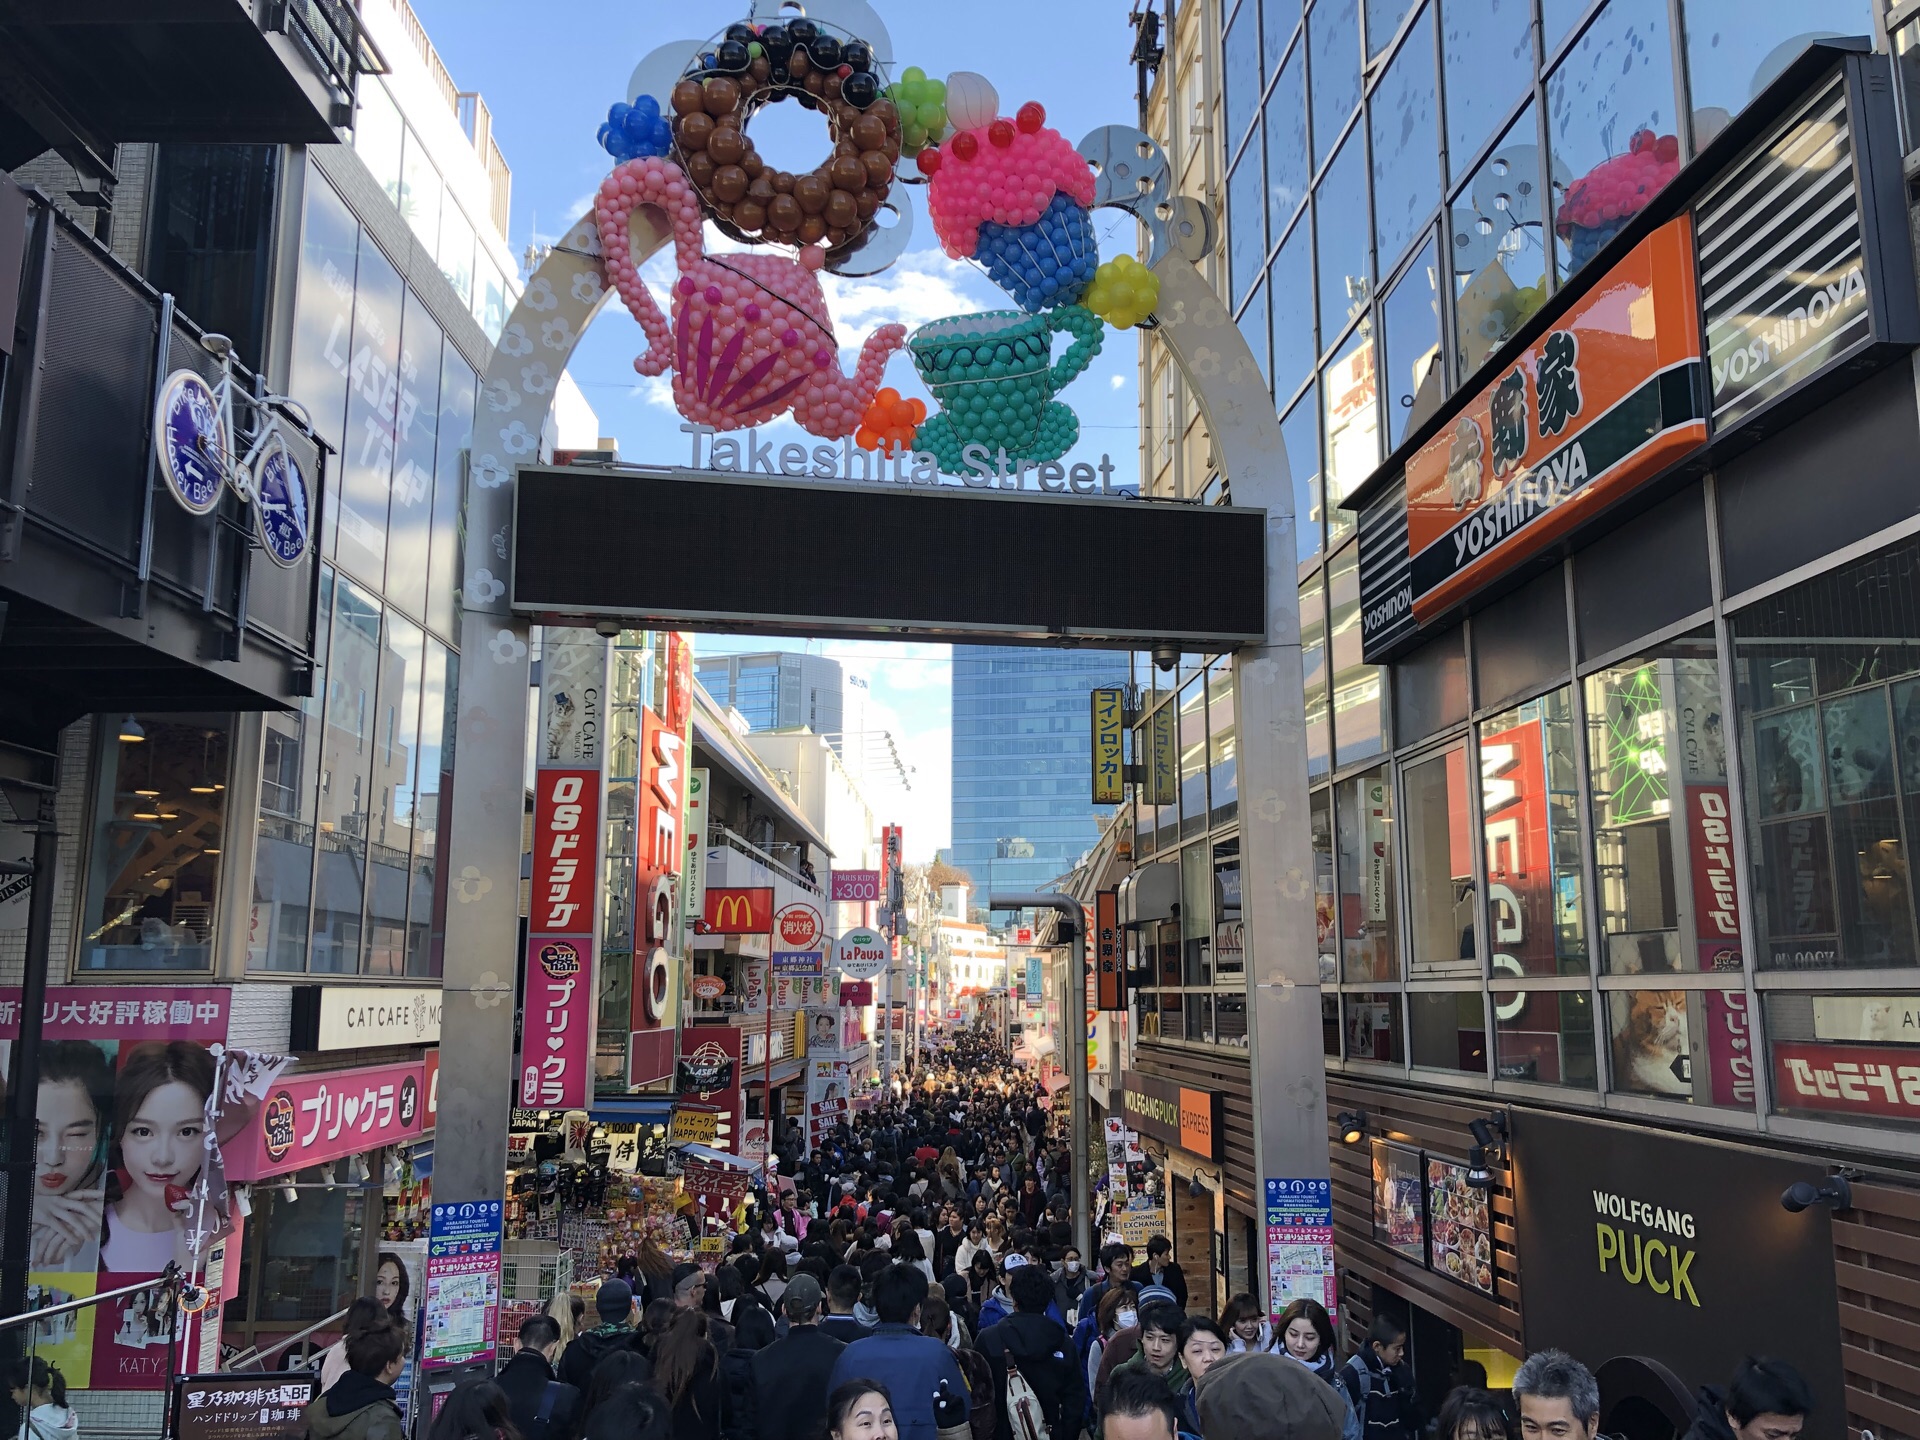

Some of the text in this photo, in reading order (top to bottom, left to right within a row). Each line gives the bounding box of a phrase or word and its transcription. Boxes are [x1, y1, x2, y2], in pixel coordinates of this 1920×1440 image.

[1713, 266, 1867, 396] YOSHINOYA
[323, 313, 418, 441] LASER
[359, 415, 430, 507] TRAP
[680, 424, 1119, 495] Takeshita Street
[193, 478, 214, 501] Bee
[1453, 441, 1588, 565] YOSHINOYA
[283, 538, 303, 557] Bee
[583, 688, 597, 759] CAT CAFE
[1098, 691, 1119, 789] コインロッカー
[546, 777, 584, 927] OSドラッグ
[837, 873, 857, 881] PARIS
[836, 883, 874, 899] ¥300
[783, 920, 813, 935] 消火栓
[841, 947, 884, 961] La Pausa
[0, 1000, 220, 1026] 新リ大好評稼働中
[347, 1007, 374, 1027] CAT
[378, 1006, 409, 1026] CAFE
[819, 1101, 839, 1112] SALE
[1124, 1089, 1178, 1127] WOLFGANG PUCK
[511, 1119, 537, 1128] JAPAN
[676, 1115, 717, 1128] ハッピーワン
[818, 1116, 838, 1127] SALE
[1182, 1109, 1209, 1136] EXPRESS
[673, 1128, 714, 1142] HAPPY ONE
[684, 1183, 746, 1198] SQUEEZE
[686, 1174, 747, 1192] スクイーズ
[1592, 1189, 1696, 1239] WOLFGANG
[1124, 1221, 1165, 1229] EXCHANGE
[430, 1260, 498, 1273] 竹下通り公式マップ
[1597, 1223, 1700, 1308] PUCK
[187, 1387, 280, 1409] 星乃珈琲店
[193, 1411, 258, 1423] ハンドドリップ
